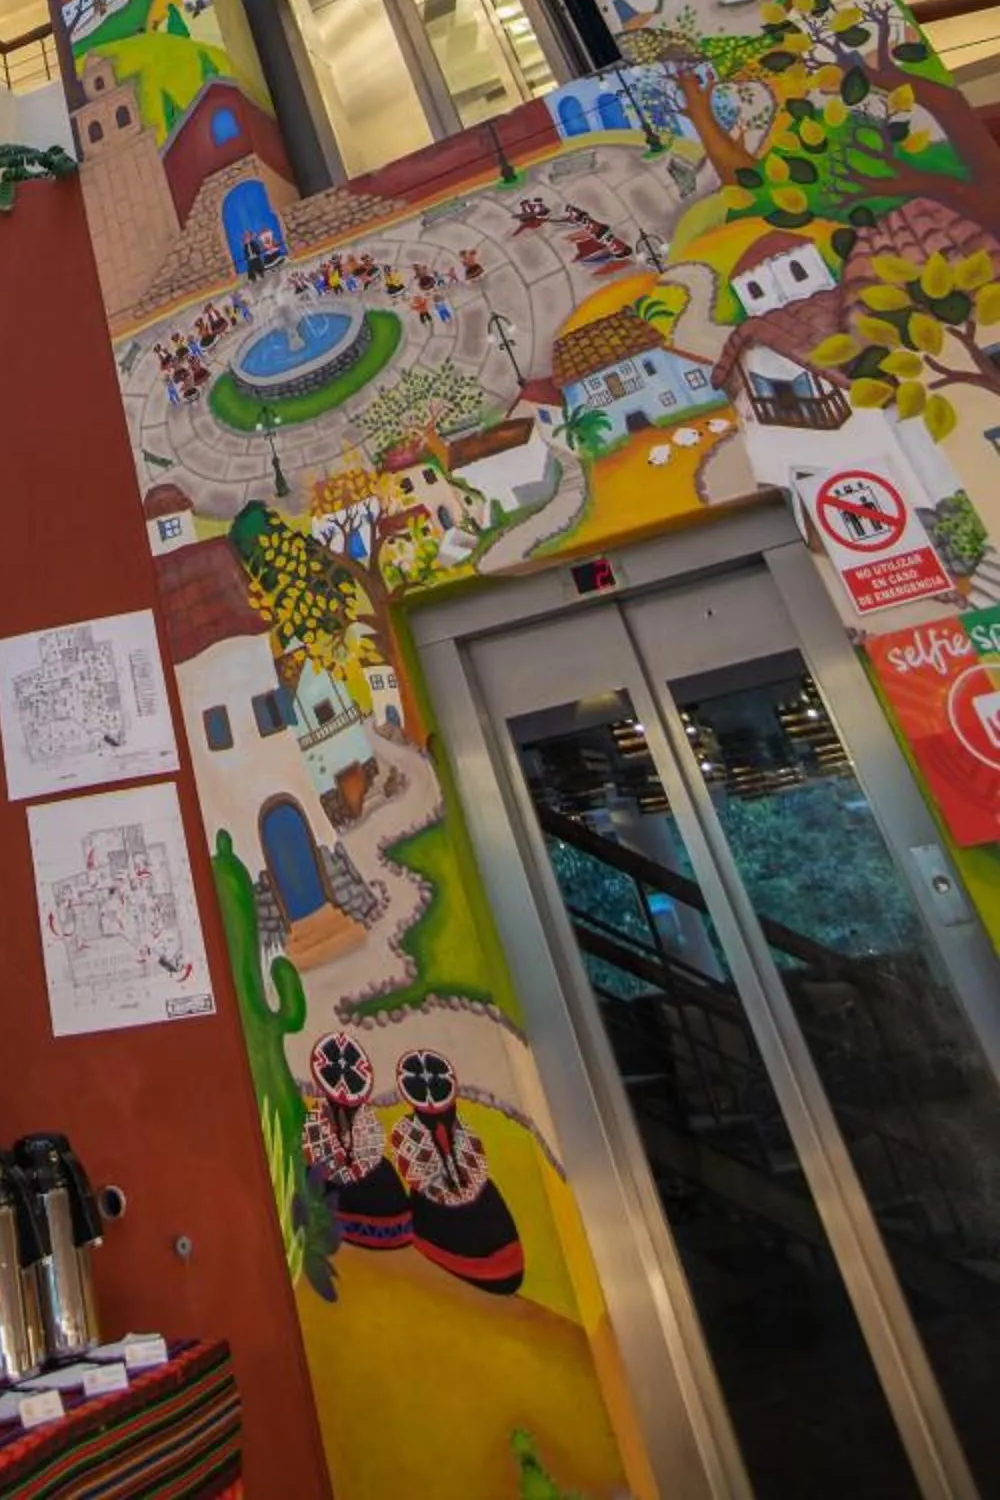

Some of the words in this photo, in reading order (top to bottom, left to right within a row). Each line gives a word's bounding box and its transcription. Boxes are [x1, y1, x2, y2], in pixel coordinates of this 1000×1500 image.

[594, 558, 613, 592] 2
[855, 568, 872, 580] NO
[873, 554, 921, 575] UTILIZAR
[872, 579, 887, 589] EN
[888, 569, 918, 584] CASO
[858, 594, 873, 606] DE
